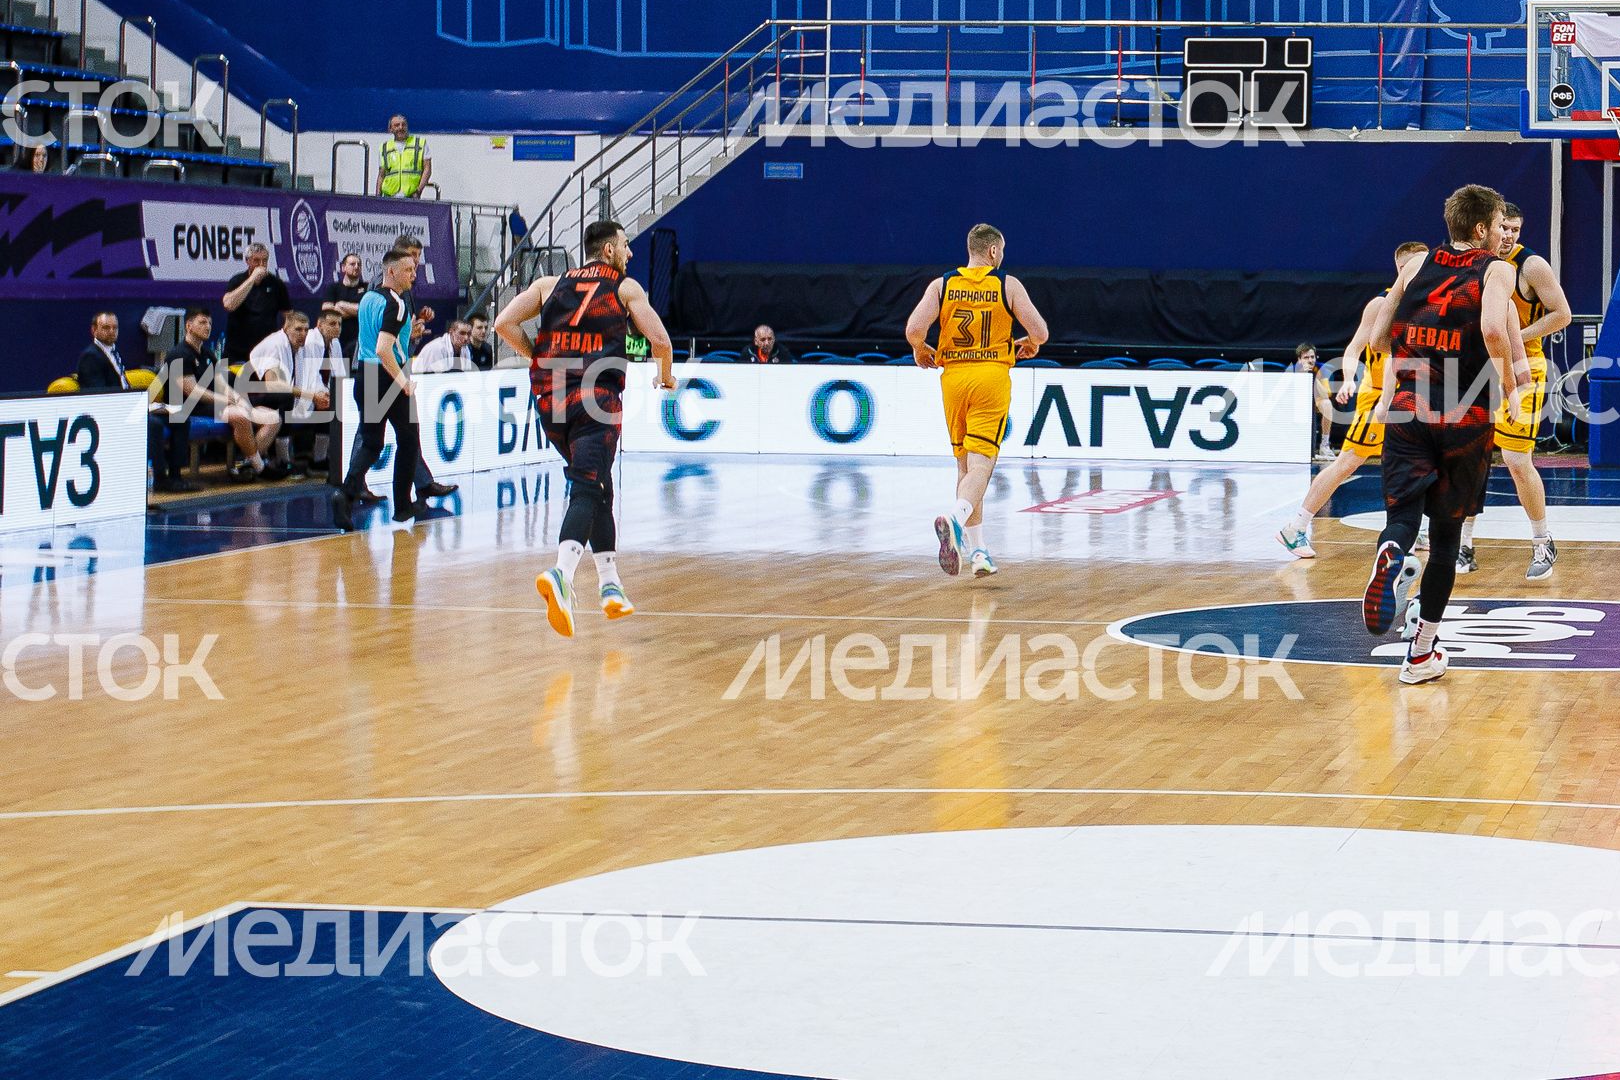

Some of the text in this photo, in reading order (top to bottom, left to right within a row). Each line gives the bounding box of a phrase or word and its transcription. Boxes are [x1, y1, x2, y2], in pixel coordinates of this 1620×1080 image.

[1552, 24, 1574, 33] FON
[1552, 33, 1574, 42] BET
[1552, 91, 1573, 101] РФБ
[332, 218, 361, 235] Фонбет
[173, 223, 255, 261] FONBET
[568, 281, 601, 327] 7
[948, 289, 999, 303] ВАРНАКОВ
[1427, 275, 1458, 317] 4
[952, 308, 992, 348] 31
[1406, 324, 1461, 352] РЕВДА
[551, 331, 603, 354] РЕВДА
